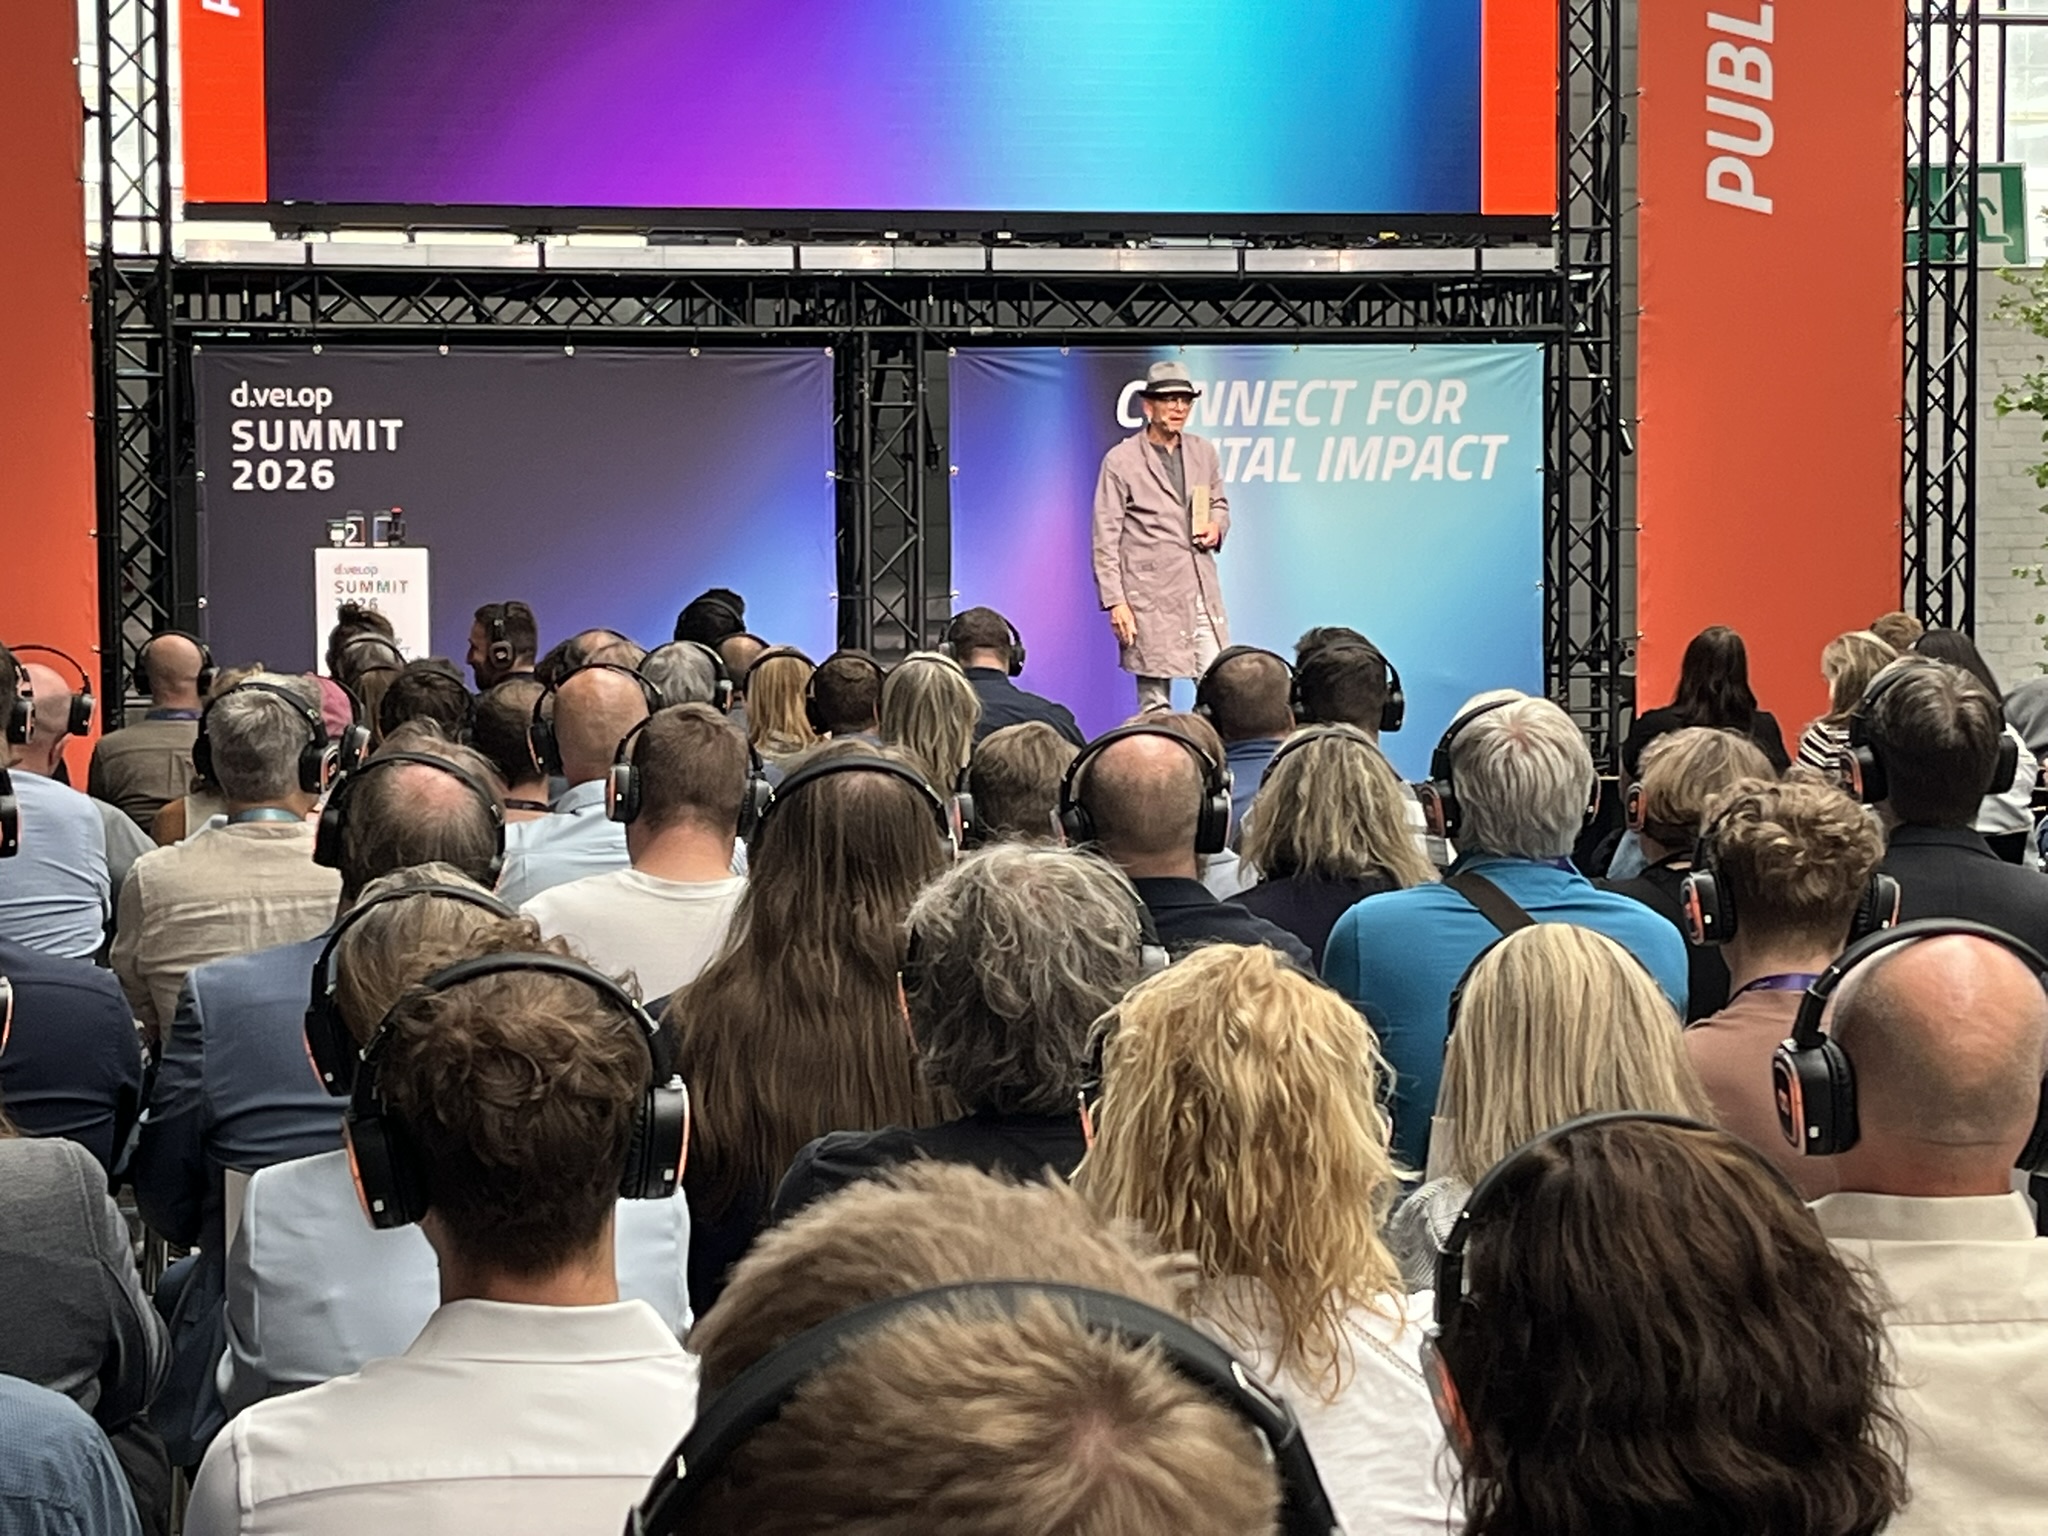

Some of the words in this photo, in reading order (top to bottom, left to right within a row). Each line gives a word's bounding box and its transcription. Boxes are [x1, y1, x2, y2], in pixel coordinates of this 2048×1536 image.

[1706, 0, 1774, 215] PUBL
[1116, 379, 1358, 428] CNNECT
[1366, 379, 1467, 426] FOR
[231, 419, 404, 452] SUMMIT
[232, 458, 335, 491] 2026
[1315, 434, 1510, 483] IMPACT
[333, 579, 409, 595] SUMMIT
